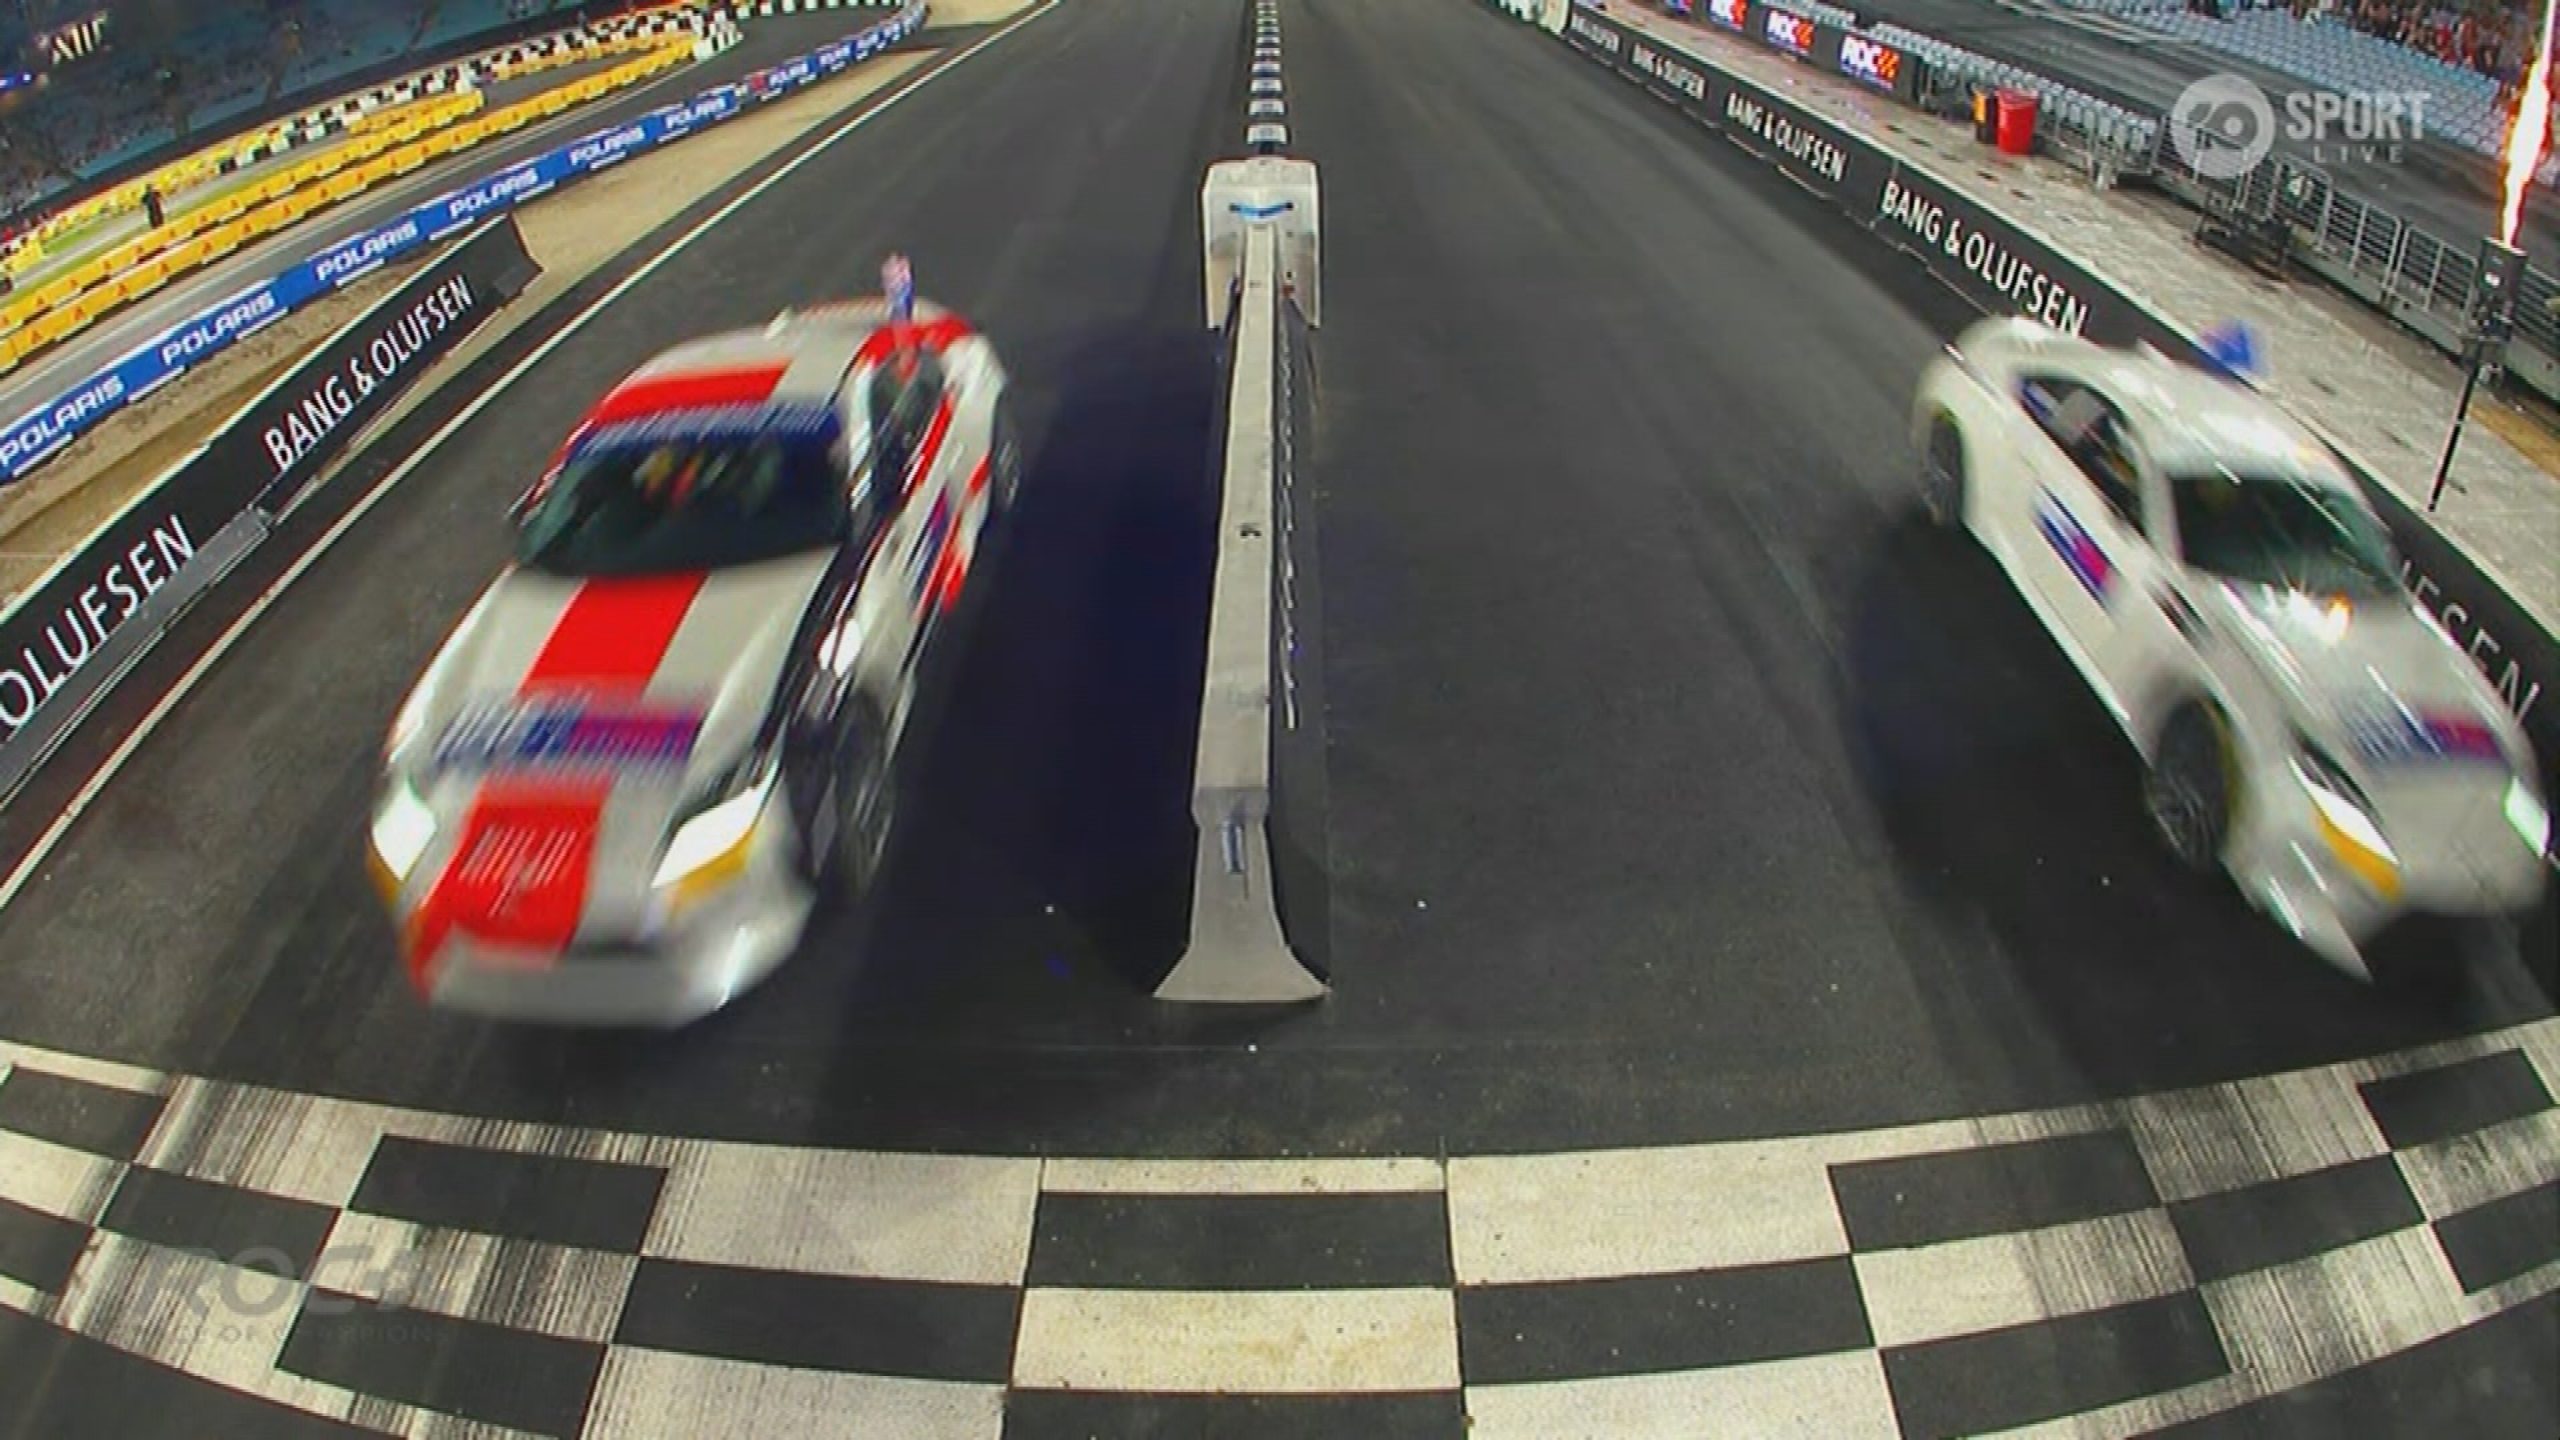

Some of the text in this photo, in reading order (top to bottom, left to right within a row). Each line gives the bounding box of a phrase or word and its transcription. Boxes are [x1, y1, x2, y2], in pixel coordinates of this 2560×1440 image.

[1727, 92, 1764, 133] BANG
[1775, 117, 1847, 182] OLUFSEN
[450, 167, 539, 218] POLARIS
[316, 221, 418, 281] POLARIS
[1881, 180, 2087, 338] BANG & OLUFSEN
[162, 290, 275, 366] POLARIS
[264, 274, 473, 473] BANG & OLUFSEN
[0, 375, 125, 466] POLARIS
[0, 513, 194, 727] OLUFSEN
